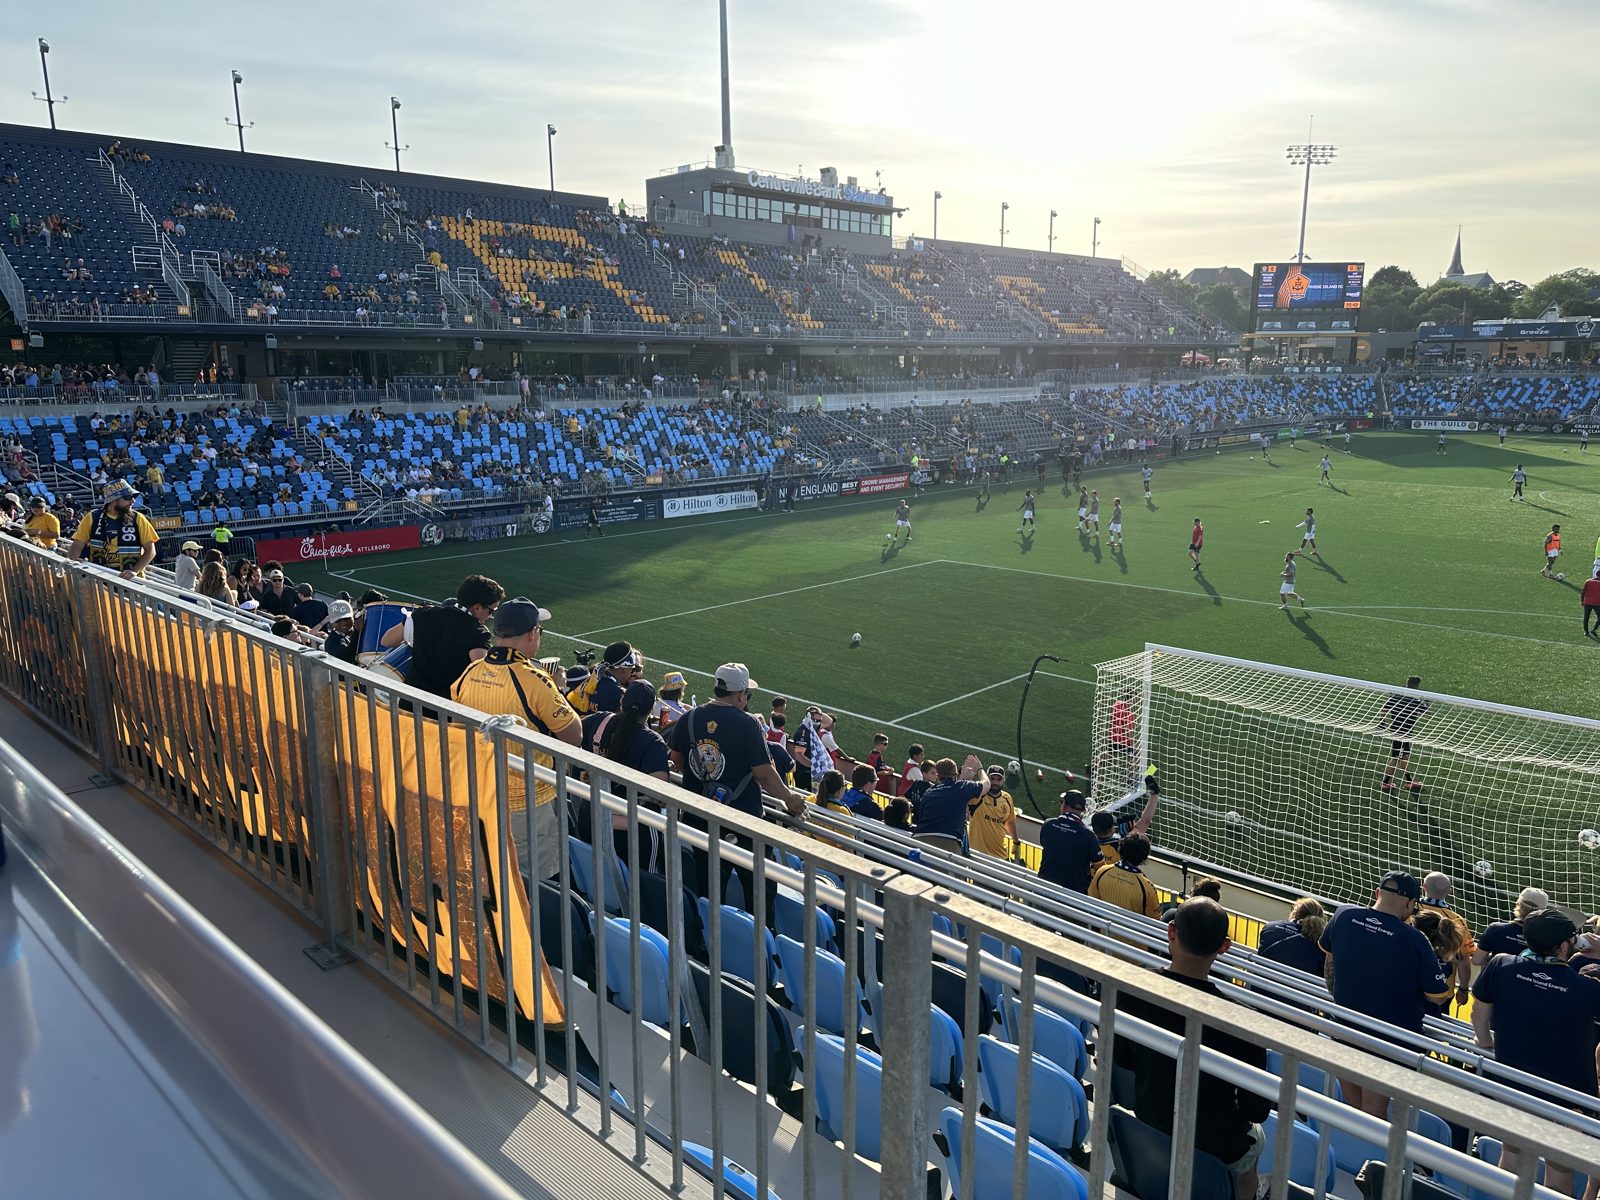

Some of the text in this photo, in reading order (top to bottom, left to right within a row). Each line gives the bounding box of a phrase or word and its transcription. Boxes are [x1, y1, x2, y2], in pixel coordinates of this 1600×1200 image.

[1423, 420, 1467, 428] THE GUILD
[841, 480, 859, 489] BEST
[861, 475, 908, 486] CROWD MANAGEMENT
[800, 482, 839, 496] ENGLAND
[870, 484, 884, 492] EVENT
[885, 482, 905, 491] SECURITY
[683, 498, 712, 510] Hilton
[730, 493, 757, 505] Hilton
[155, 519, 176, 528] 112-111
[506, 523, 517, 536] 37
[300, 537, 391, 559] Chick-fil-A ATTLEBORO
[1351, 917, 1365, 926] Rhode
[1364, 923, 1378, 931] Island
[1377, 926, 1393, 936] Energy
[1516, 973, 1533, 982] Rhode
[1533, 979, 1548, 987] Island
[1547, 983, 1567, 993] Energy
